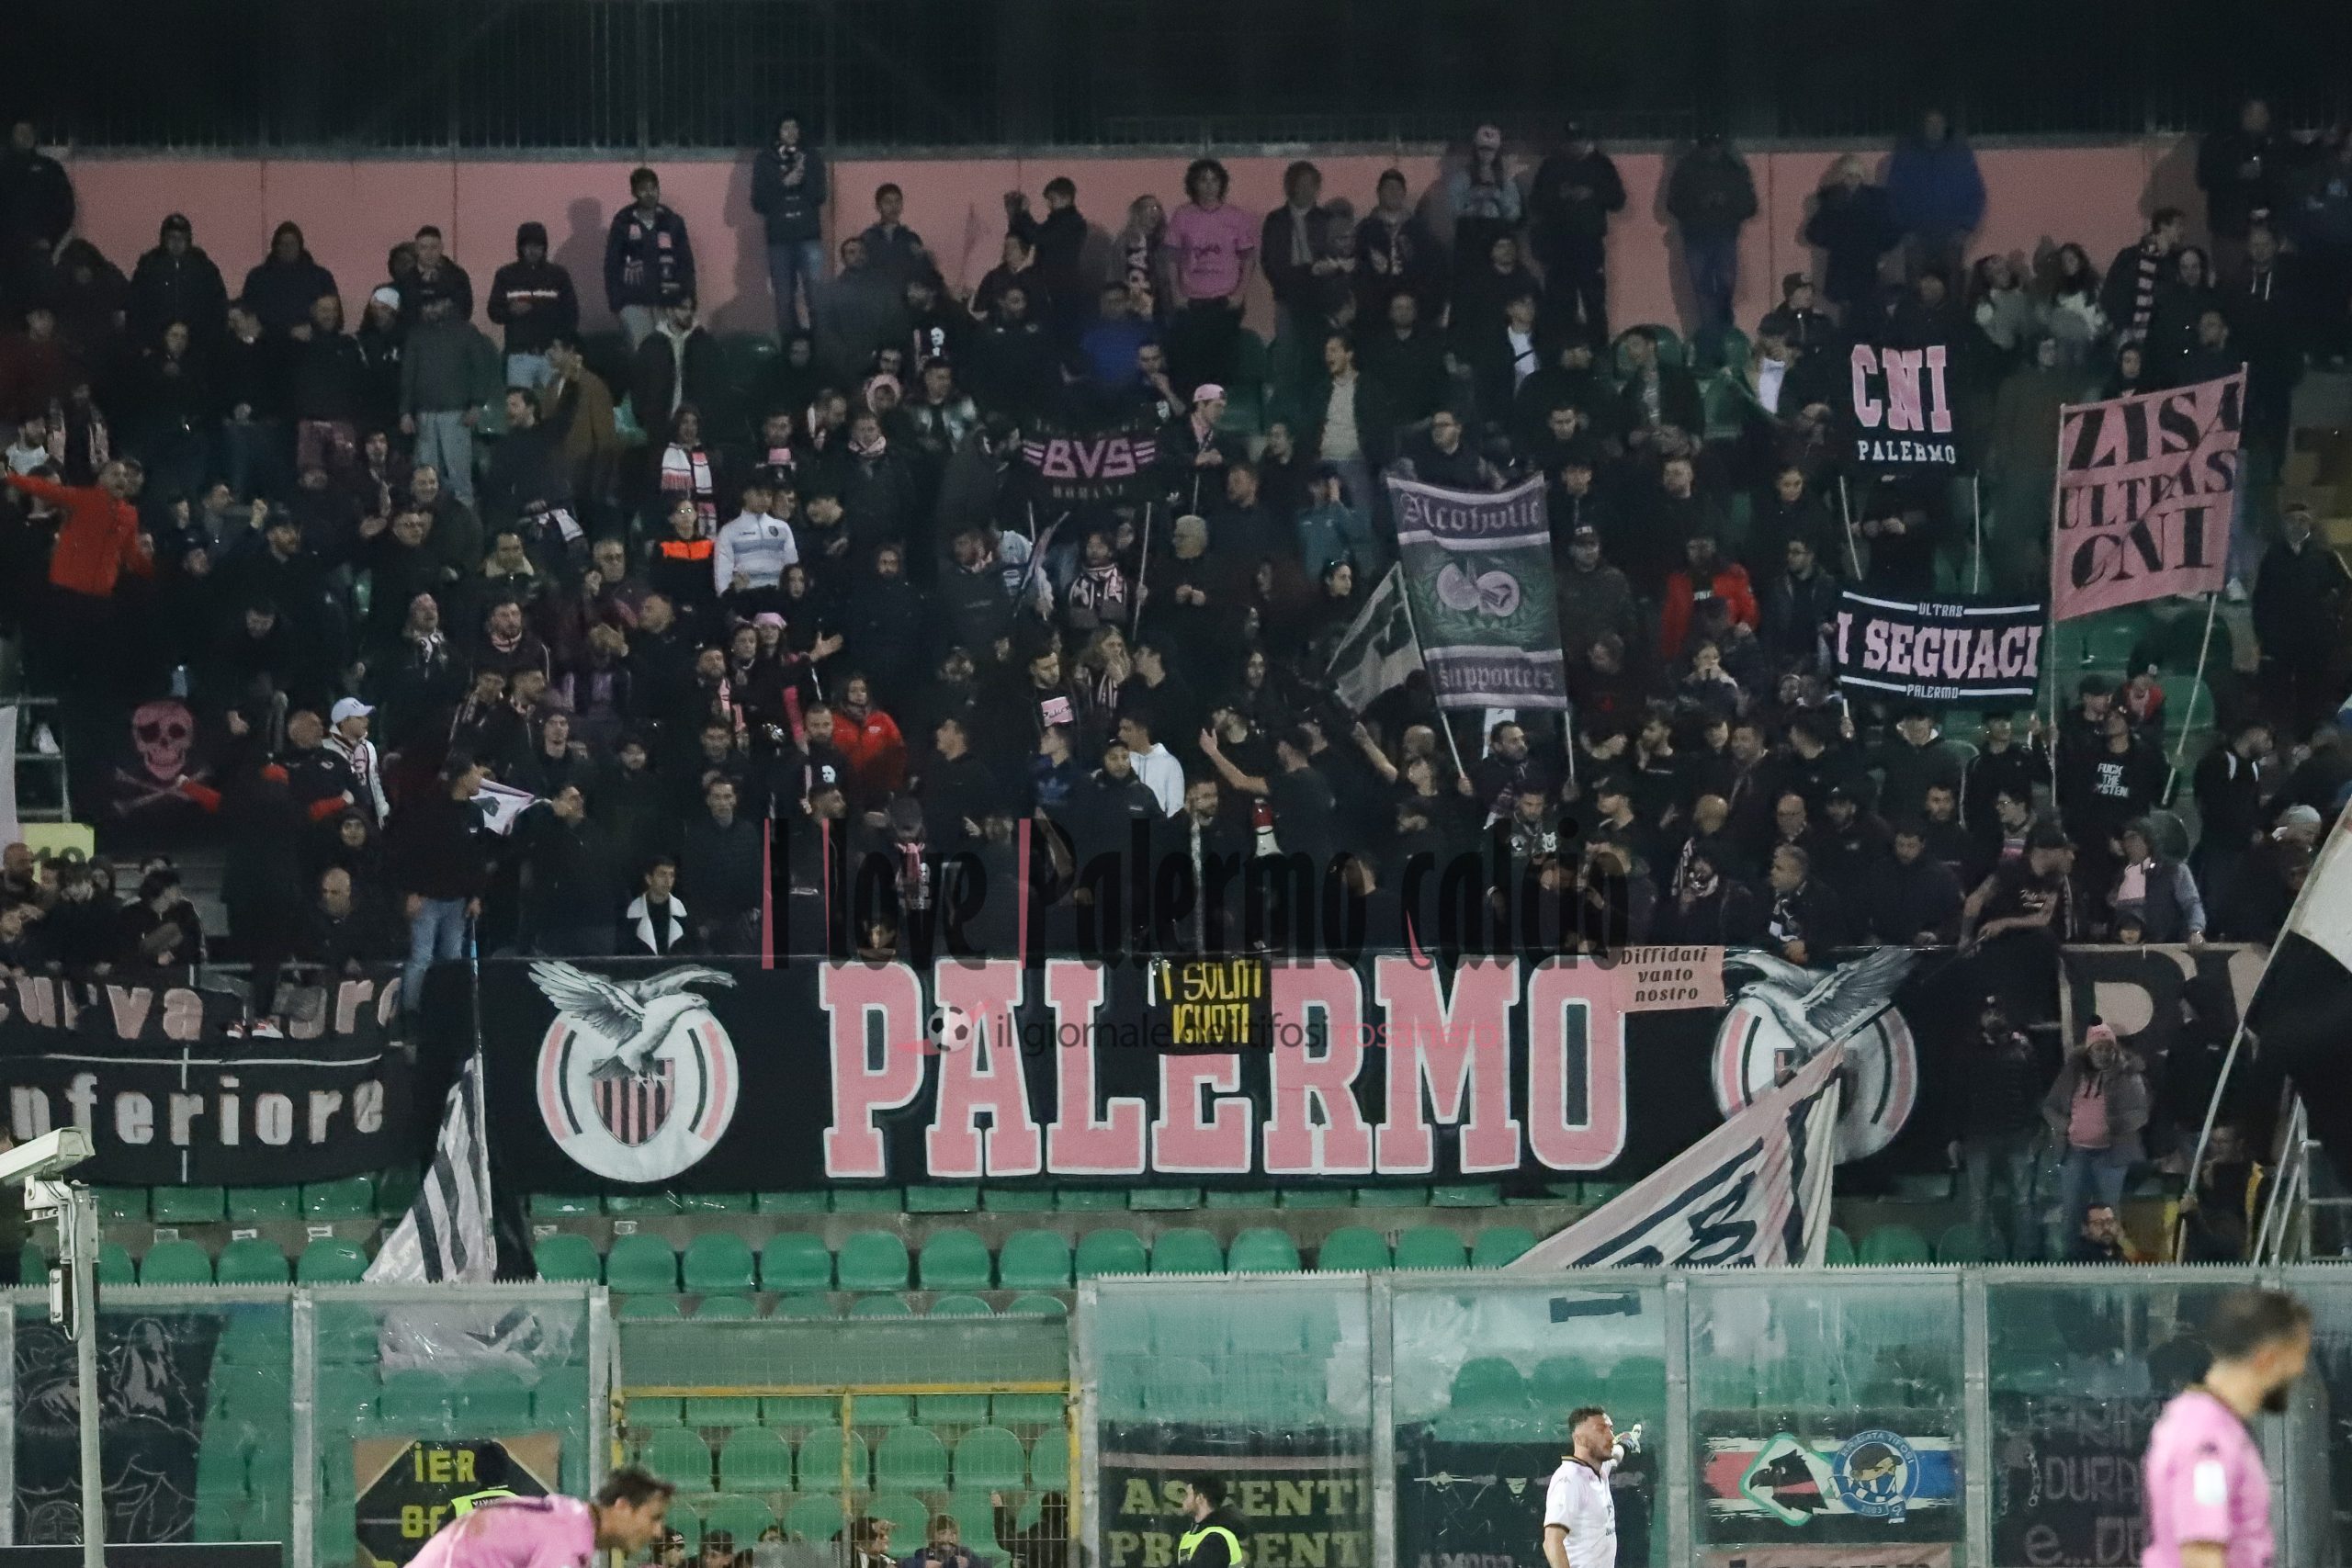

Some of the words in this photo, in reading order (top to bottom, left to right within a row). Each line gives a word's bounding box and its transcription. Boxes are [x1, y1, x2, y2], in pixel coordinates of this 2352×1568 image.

[1850, 344, 1952, 433] CNI
[2064, 381, 2241, 470] ZISA
[1042, 438, 1136, 479] BVS
[1858, 440, 1956, 464] PALERMO
[2058, 450, 2237, 529] ULTRAS
[2071, 505, 2221, 590] CNI
[1917, 603, 1963, 617] ULTRAS
[1838, 611, 1852, 664] I
[1862, 618, 2043, 680] SEGUACI
[1906, 682, 1959, 699] PALERMO
[2098, 763, 2123, 775] FUCK
[1621, 947, 1707, 964] Diffidati
[1638, 967, 1692, 982] vanto
[1183, 959, 1261, 1000] SOLITI
[1635, 987, 1698, 1002] nostro
[1173, 1003, 1250, 1043] IGNOTI
[819, 957, 1626, 1178] PALERMO
